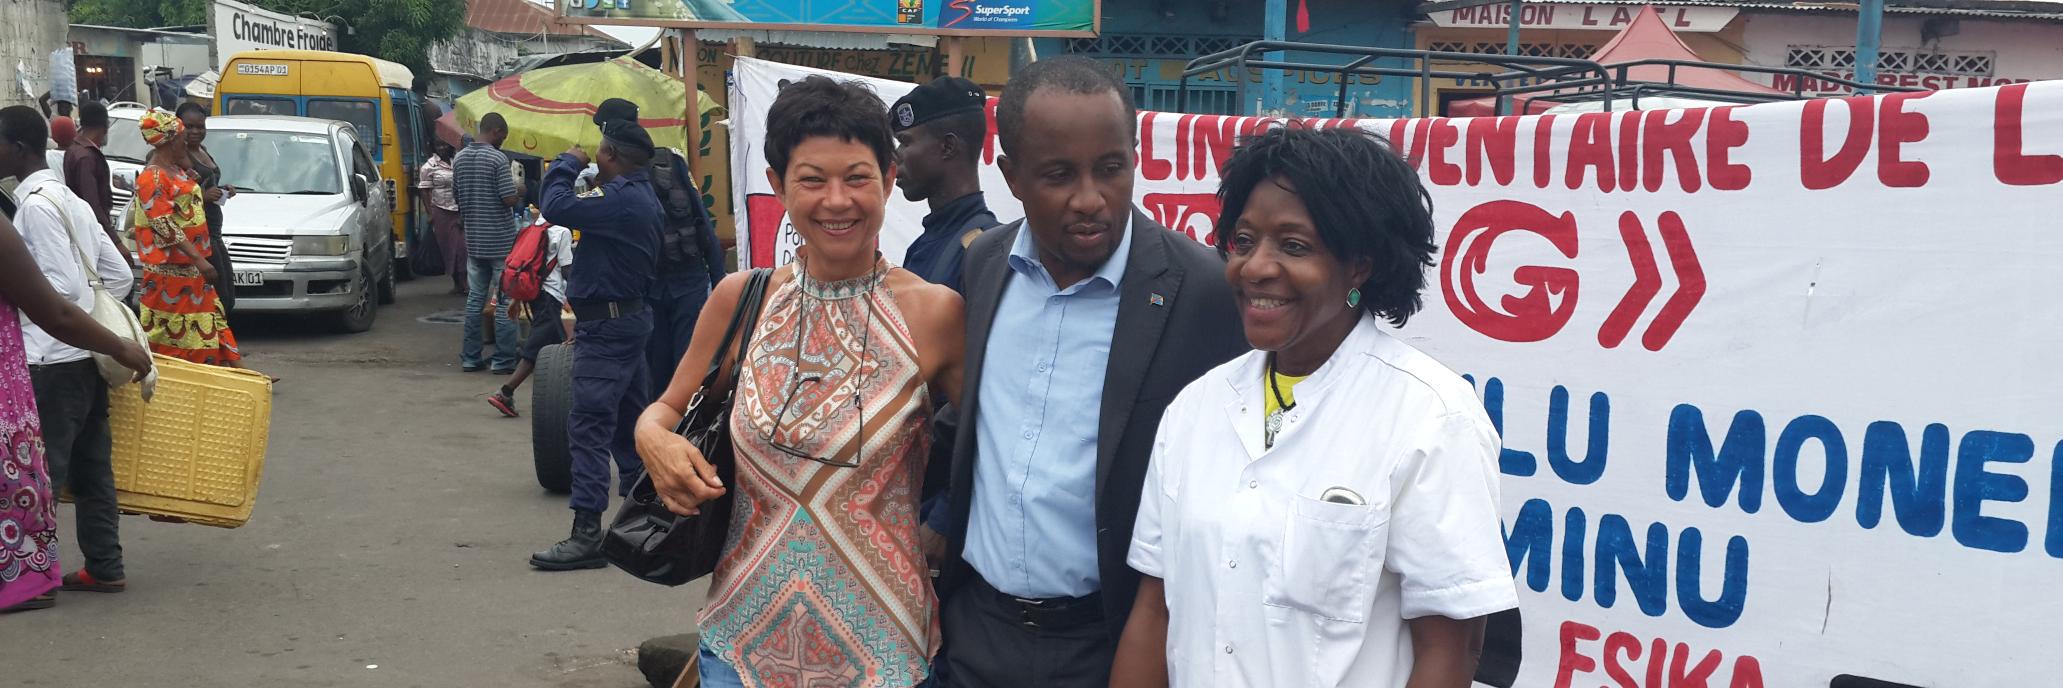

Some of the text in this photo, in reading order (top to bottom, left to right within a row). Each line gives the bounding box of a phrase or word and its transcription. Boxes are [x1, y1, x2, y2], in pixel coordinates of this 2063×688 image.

[975, 4, 1030, 16] SuperSport
[1452, 5, 1555, 25] MAISON
[233, 12, 333, 51] Chambre Froide
[1800, 89, 1931, 190] DE
[247, 272, 262, 284] 01
